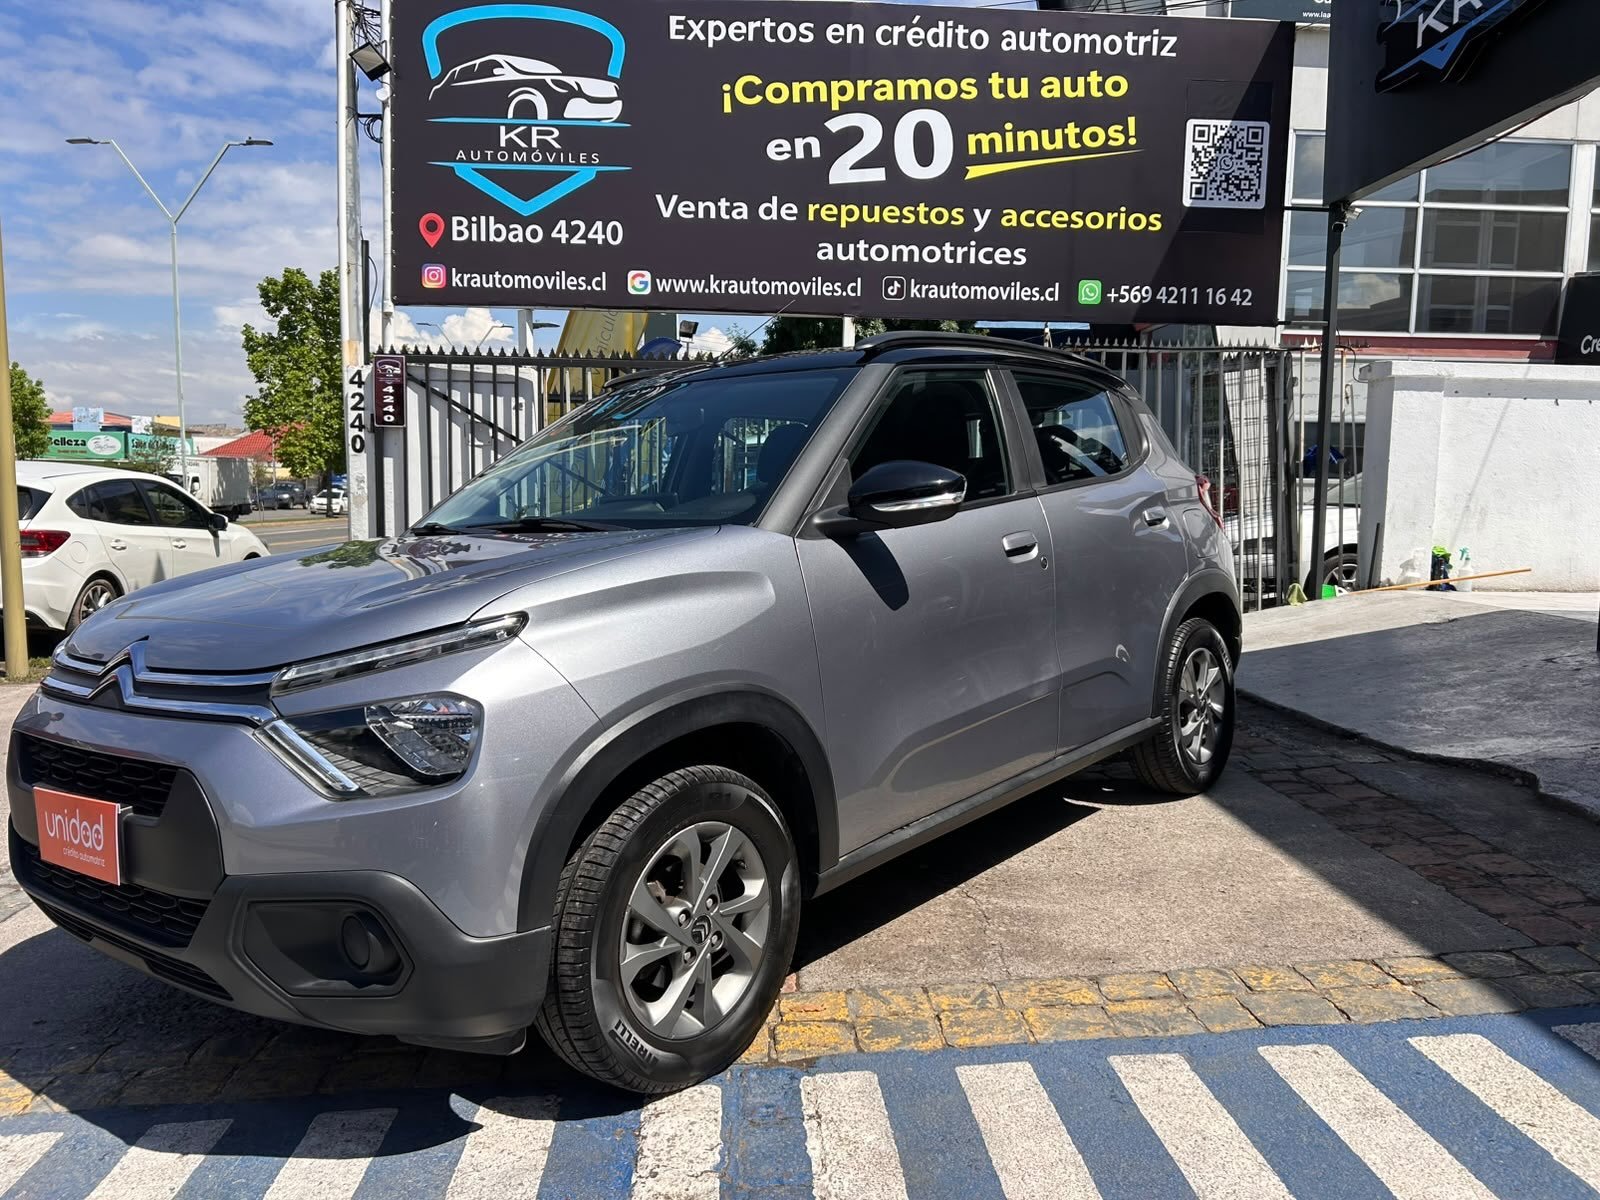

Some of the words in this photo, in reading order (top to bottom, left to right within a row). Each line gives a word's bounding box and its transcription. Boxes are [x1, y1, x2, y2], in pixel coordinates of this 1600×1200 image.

[670, 16, 814, 47] Expertos
[826, 24, 864, 44] en
[876, 15, 989, 50] crédito
[1001, 28, 1177, 57] automotriz
[722, 75, 978, 113] ¡Compramos
[988, 72, 1028, 99] tu
[1041, 70, 1128, 98] auto
[500, 125, 562, 149] KR
[767, 136, 820, 161] en
[824, 108, 953, 184] 20
[968, 117, 1138, 155] minutos!
[456, 149, 600, 164] AUTOMÓVILES
[656, 194, 748, 219] Venta
[758, 196, 798, 220] de
[808, 203, 964, 228] repuestos
[973, 209, 991, 232] y
[1001, 207, 1161, 230] accesorios
[451, 216, 543, 243] Bilbao
[551, 220, 623, 245] 4240
[817, 240, 1026, 265] automotrices
[452, 268, 606, 290] krautomoviles.cl
[656, 274, 861, 296] www.krautomoviles.cl
[911, 279, 1059, 301] krautomoviles.cl
[1107, 286, 1152, 303] +569
[1157, 287, 1197, 304] 4211
[1207, 288, 1226, 305] 16
[1231, 289, 1251, 305] 42
[349, 369, 366, 454] 4240
[382, 385, 395, 423] 4240
[45, 808, 104, 851] unidad
